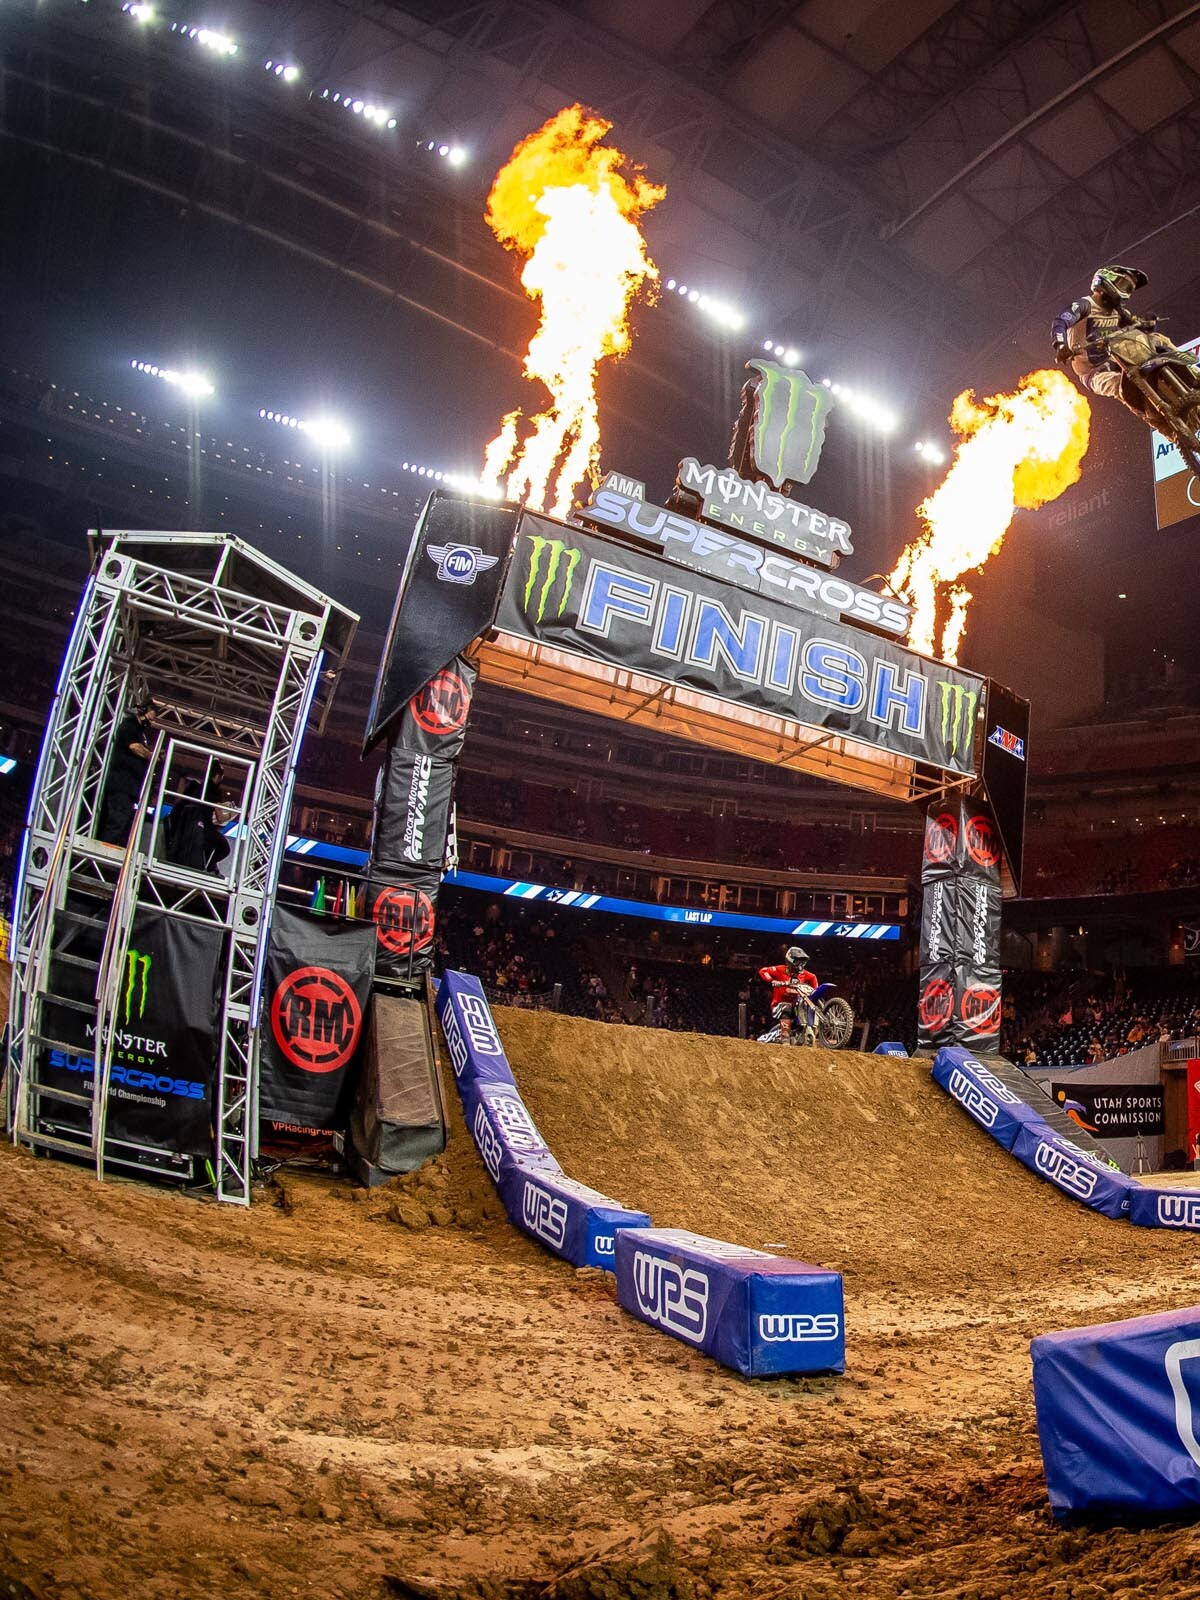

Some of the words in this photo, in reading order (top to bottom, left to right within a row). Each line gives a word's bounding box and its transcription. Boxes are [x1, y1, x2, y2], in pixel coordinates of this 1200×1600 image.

[606, 474, 644, 500] AMA
[708, 505, 828, 557] ENERGY
[447, 556, 472, 571] FIM
[588, 490, 913, 632] SUPERCROSS
[576, 557, 931, 740] FINISH
[987, 724, 1025, 761] AMA
[407, 753, 422, 807] MOUNTAIN
[404, 807, 416, 843] ROCKY
[684, 910, 699, 922] LAST
[700, 912, 713, 924] LAP
[441, 998, 468, 1078] WPS
[457, 991, 503, 1057] WPS
[100, 1047, 156, 1066] ERGY
[118, 1089, 167, 1108] Championship
[949, 1067, 1000, 1128] WPS
[963, 1060, 1024, 1105] WPS
[1093, 1097, 1123, 1109] UTAH
[1127, 1095, 1162, 1109] SPORTS
[1094, 1111, 1162, 1125] COMMISSION
[474, 1101, 503, 1184] WPS
[1034, 1141, 1099, 1200] WPS
[522, 1180, 568, 1250] WPS
[634, 1250, 710, 1344] WPS
[759, 1312, 840, 1342] WPS
